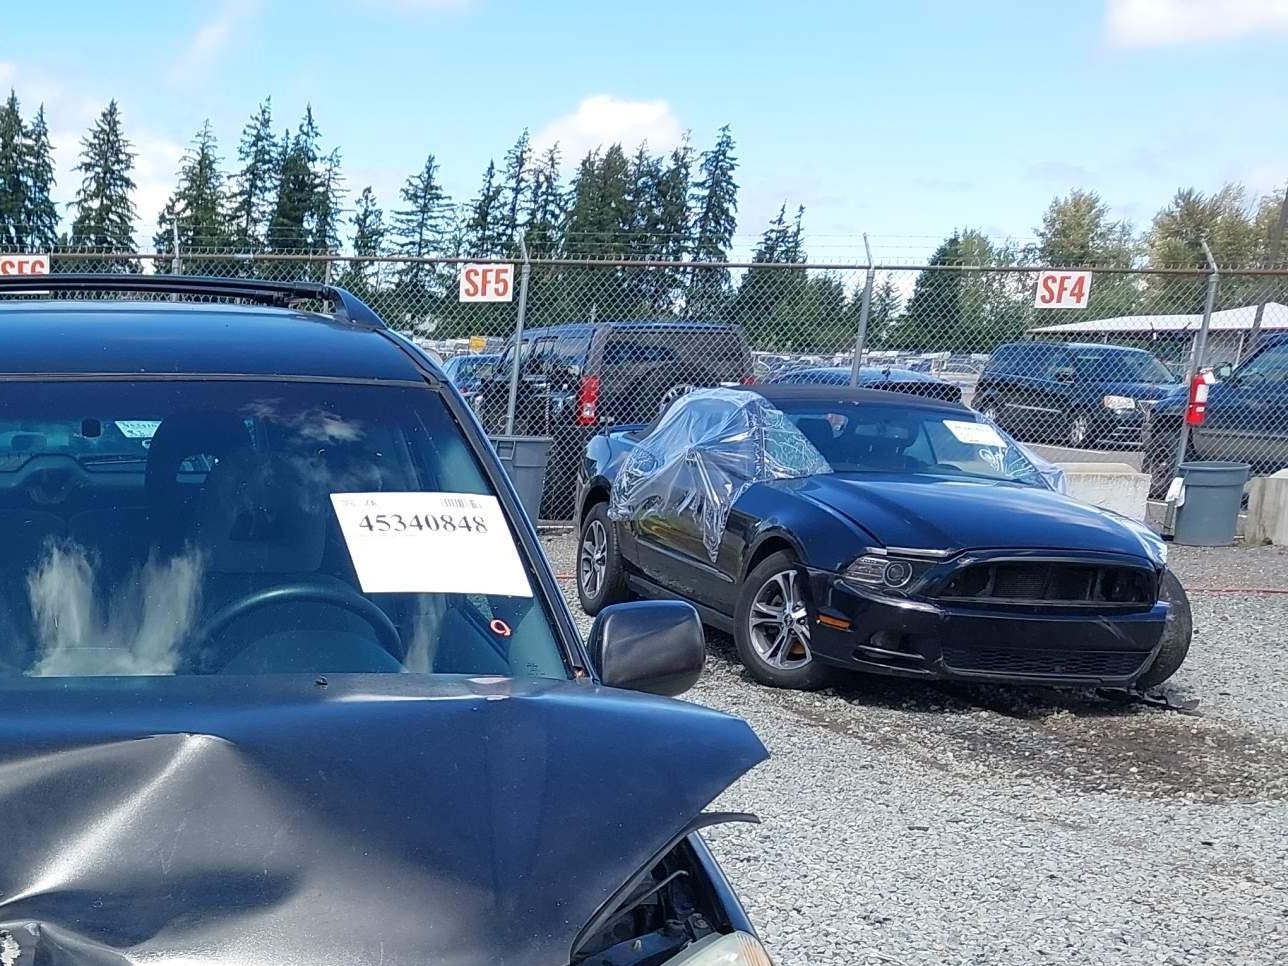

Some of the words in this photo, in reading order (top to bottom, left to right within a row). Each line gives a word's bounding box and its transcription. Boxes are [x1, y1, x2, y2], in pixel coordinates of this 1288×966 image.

[464, 268, 509, 297] SF5
[1040, 274, 1085, 304] SF4
[359, 513, 489, 534] 45340848
